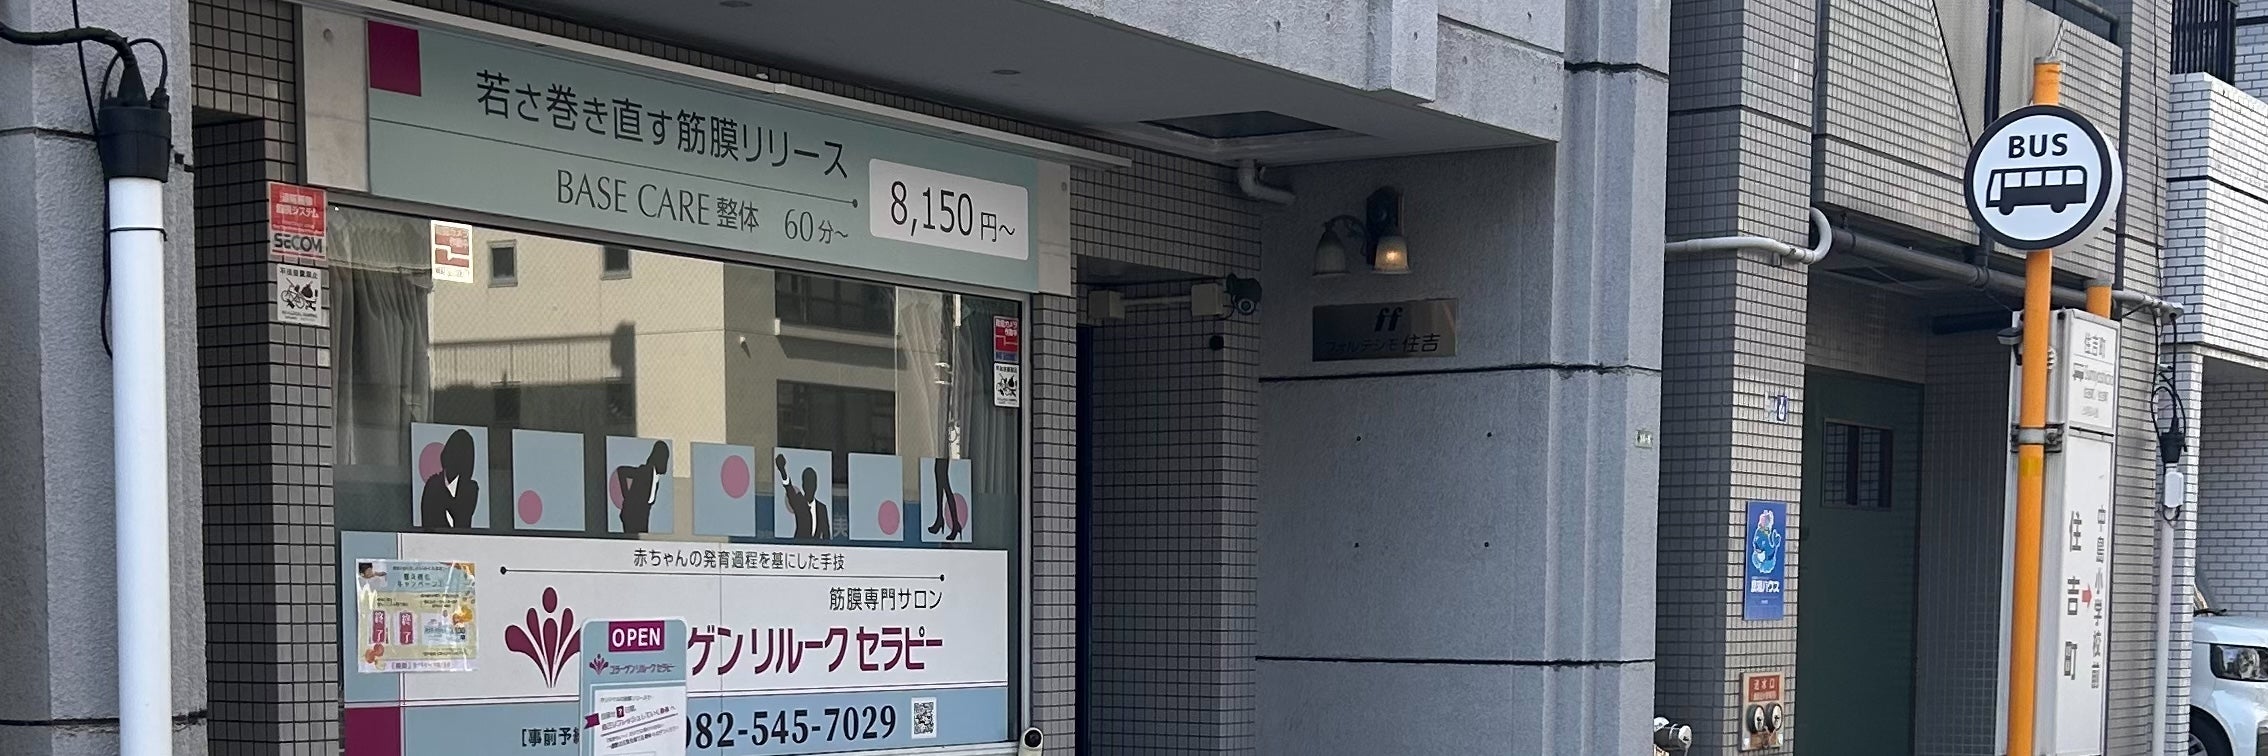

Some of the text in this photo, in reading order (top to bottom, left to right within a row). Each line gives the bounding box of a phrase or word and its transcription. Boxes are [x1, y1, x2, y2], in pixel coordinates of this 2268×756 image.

[476, 68, 849, 180] 若さ巻き直す筋膜リリース
[2008, 133, 2068, 159] BUS
[557, 169, 631, 213] BASE
[639, 181, 711, 227] CARE
[715, 197, 761, 234] 整体
[274, 232, 323, 253] SECOM
[633, 547, 845, 571] 赤ちゃんの発育過程を基にした手技
[829, 586, 943, 611] 筋膜専門サロン
[2063, 510, 2082, 681] 住吉町
[612, 627, 661, 648] OPEN
